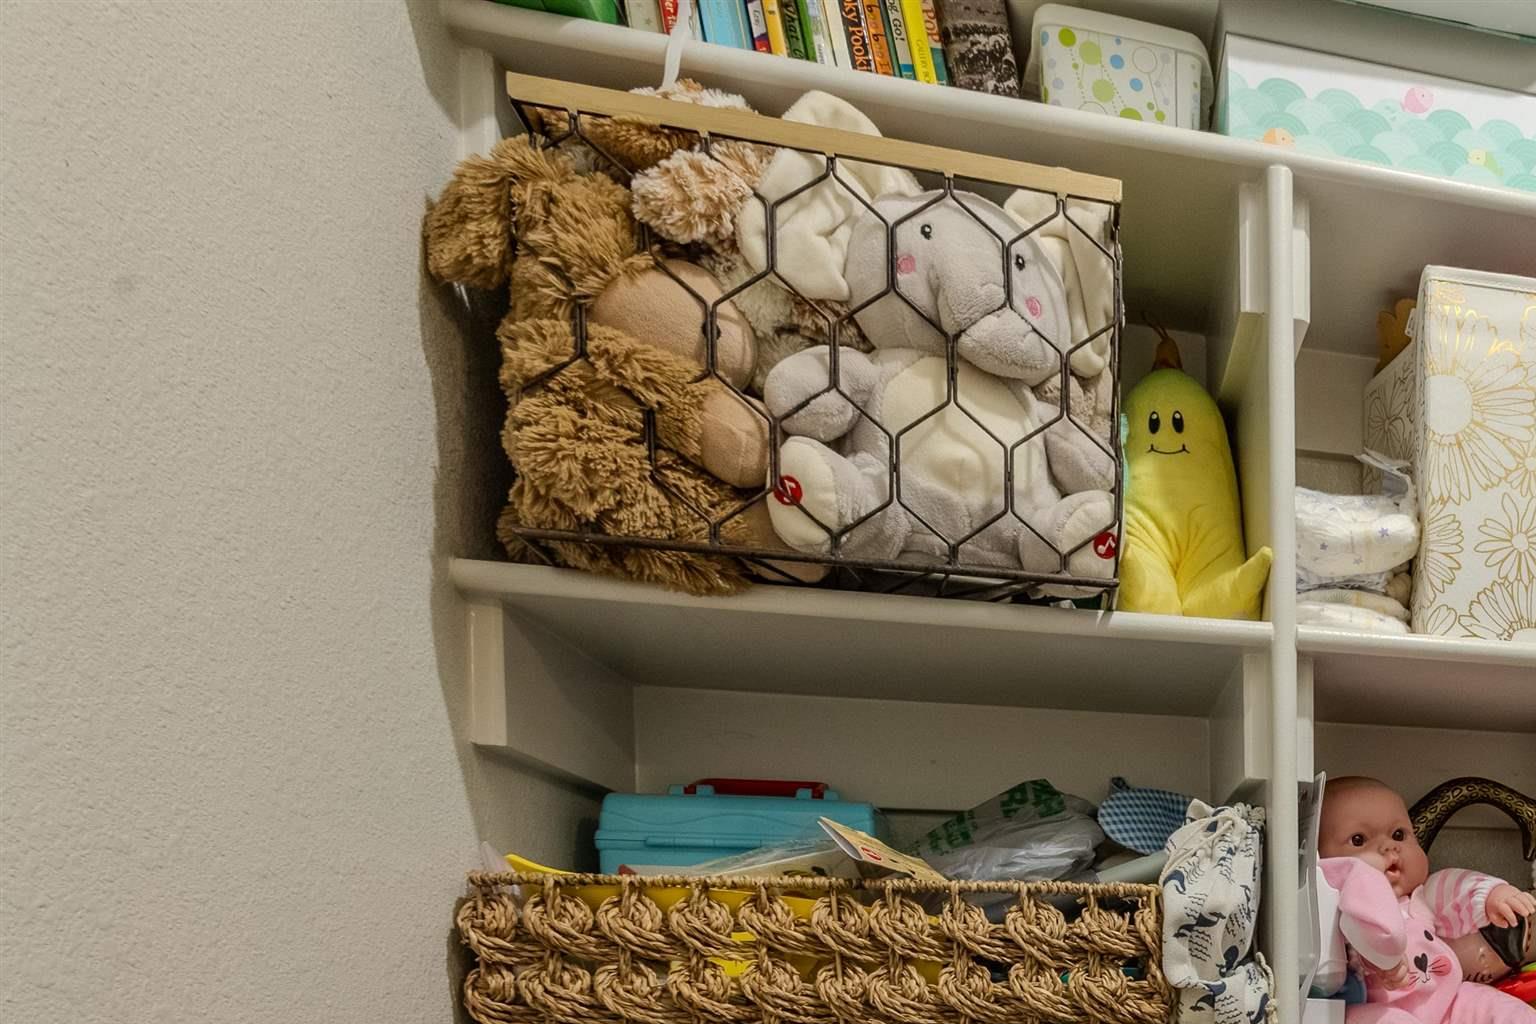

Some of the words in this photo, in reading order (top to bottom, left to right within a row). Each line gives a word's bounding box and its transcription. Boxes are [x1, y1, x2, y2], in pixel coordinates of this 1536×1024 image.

[842, 0, 858, 23] ky
[922, 8, 944, 43] POP
[892, 18, 905, 41] Go!
[848, 26, 872, 70] Pooki
